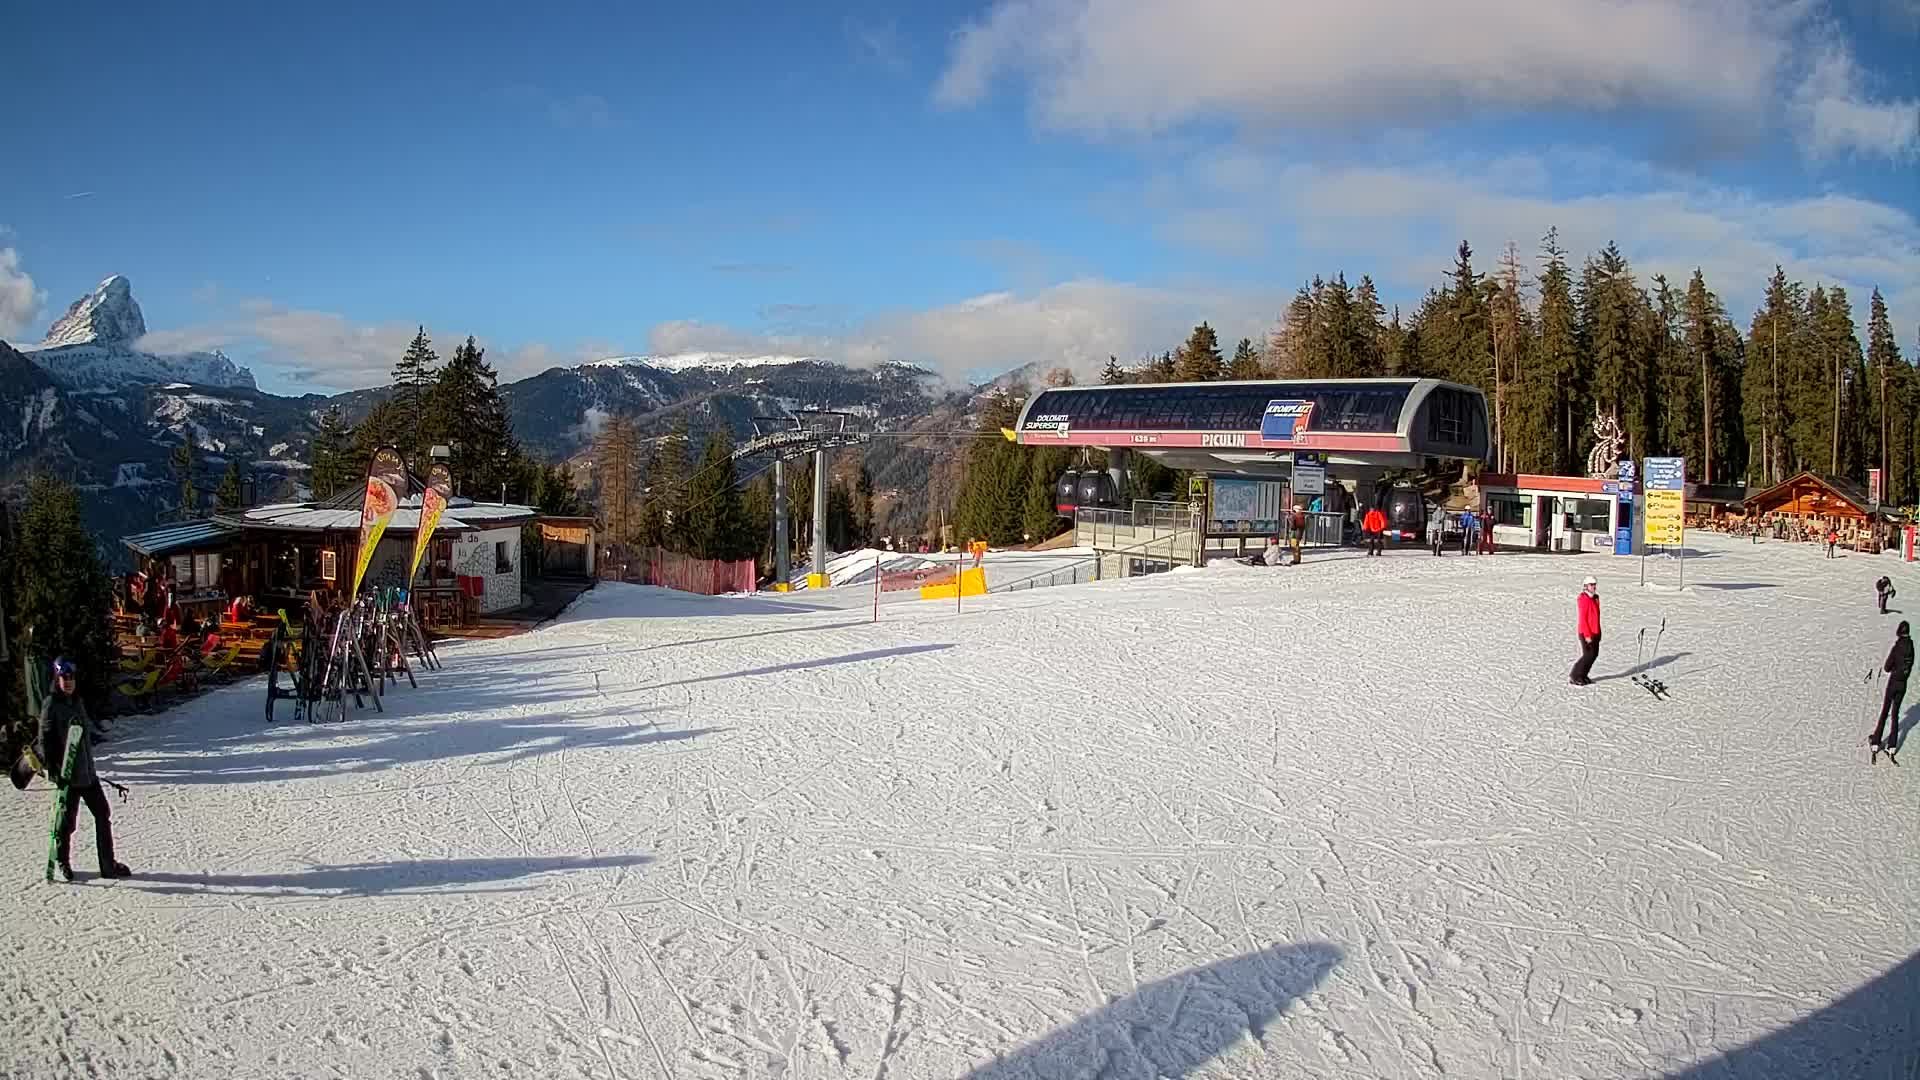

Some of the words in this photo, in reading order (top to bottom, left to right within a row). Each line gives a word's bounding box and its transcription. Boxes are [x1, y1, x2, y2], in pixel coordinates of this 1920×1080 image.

[1036, 414, 1069, 422] DOLOMITI
[1025, 422, 1059, 430] SUPERSKI
[1201, 433, 1246, 448] PICULIN
